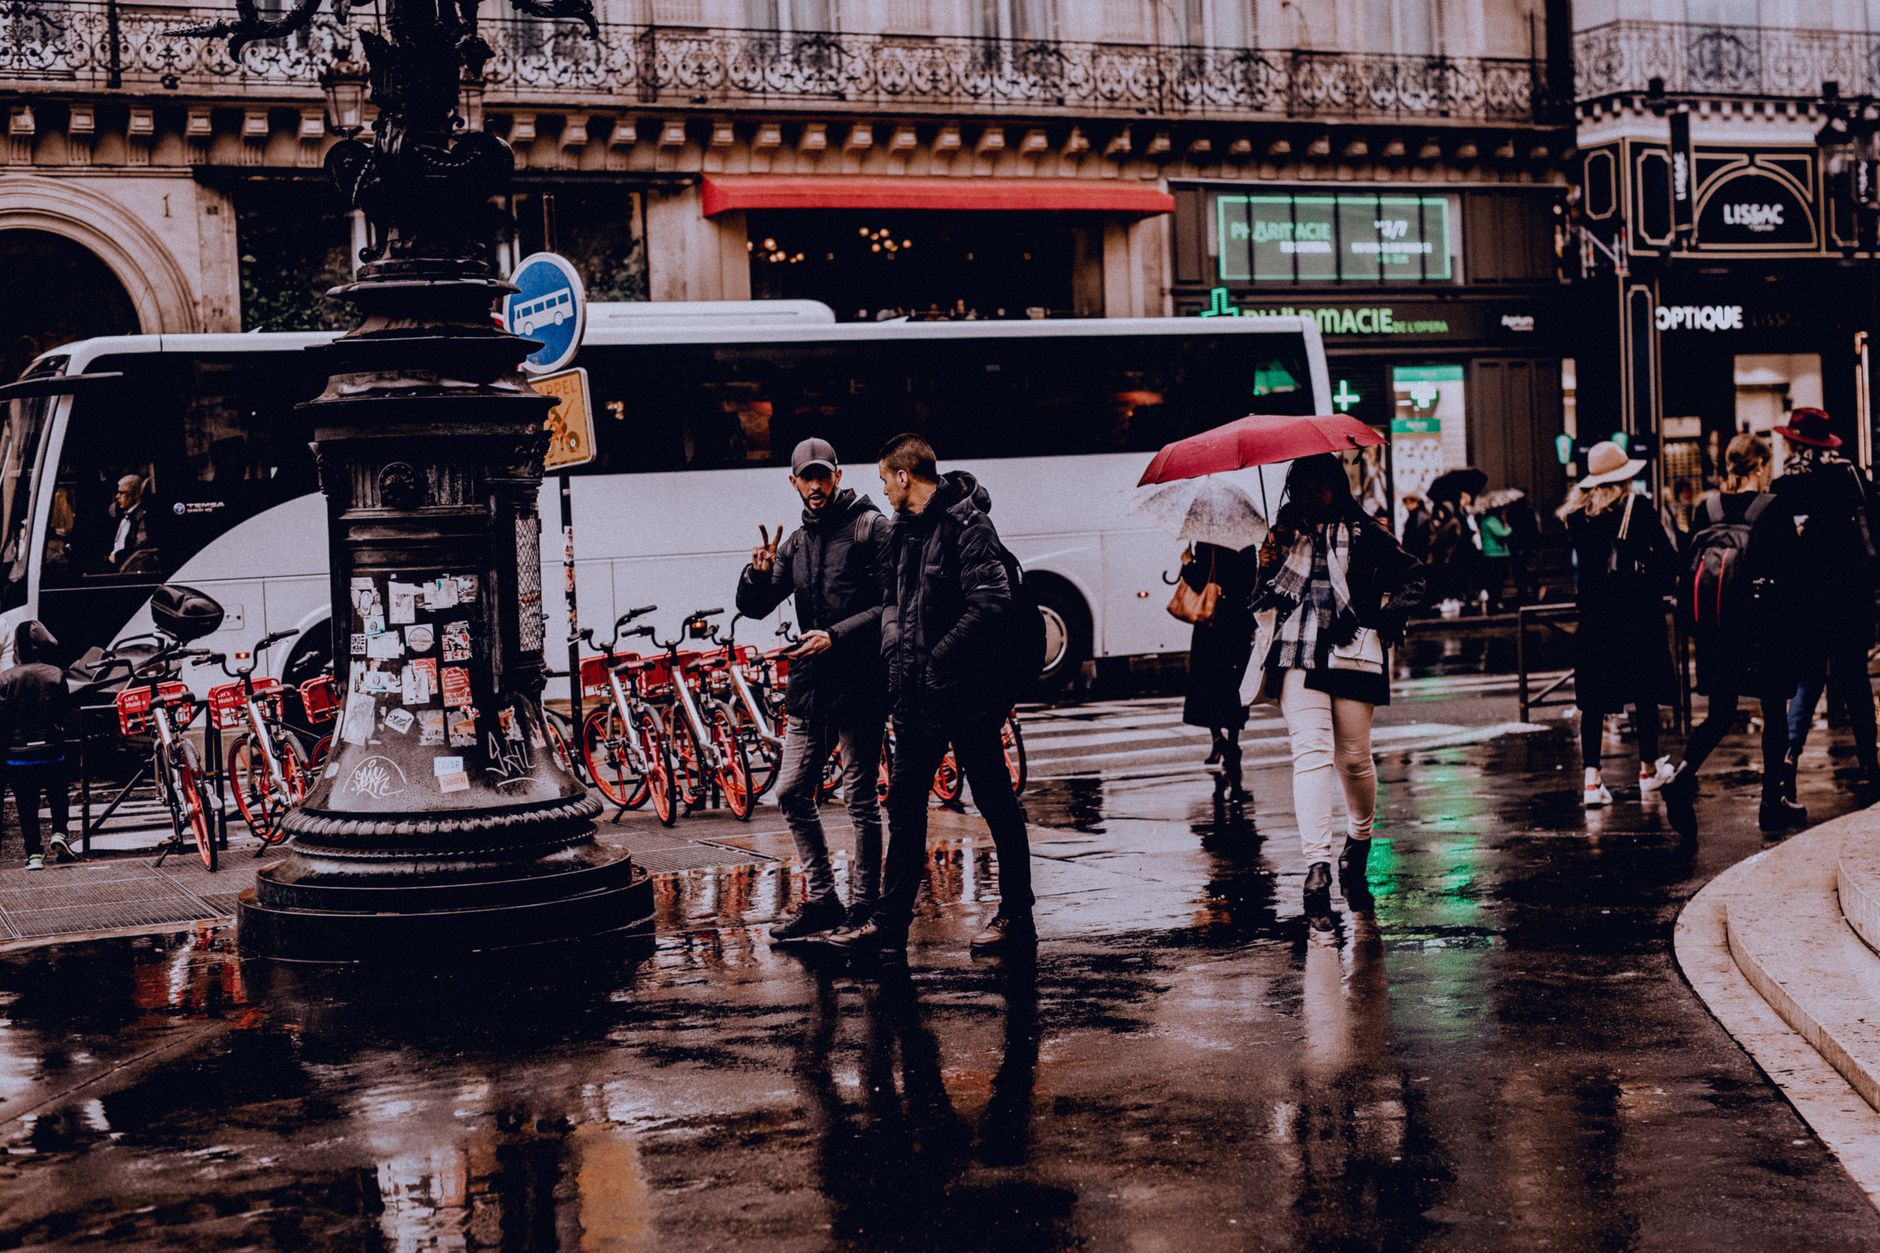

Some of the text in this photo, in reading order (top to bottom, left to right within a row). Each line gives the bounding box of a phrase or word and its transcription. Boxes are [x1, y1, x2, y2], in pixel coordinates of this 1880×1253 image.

[1723, 203, 1784, 225] LISSAC
[1243, 306, 1394, 334] MACIE
[1655, 306, 1744, 332] OPTIQUE
